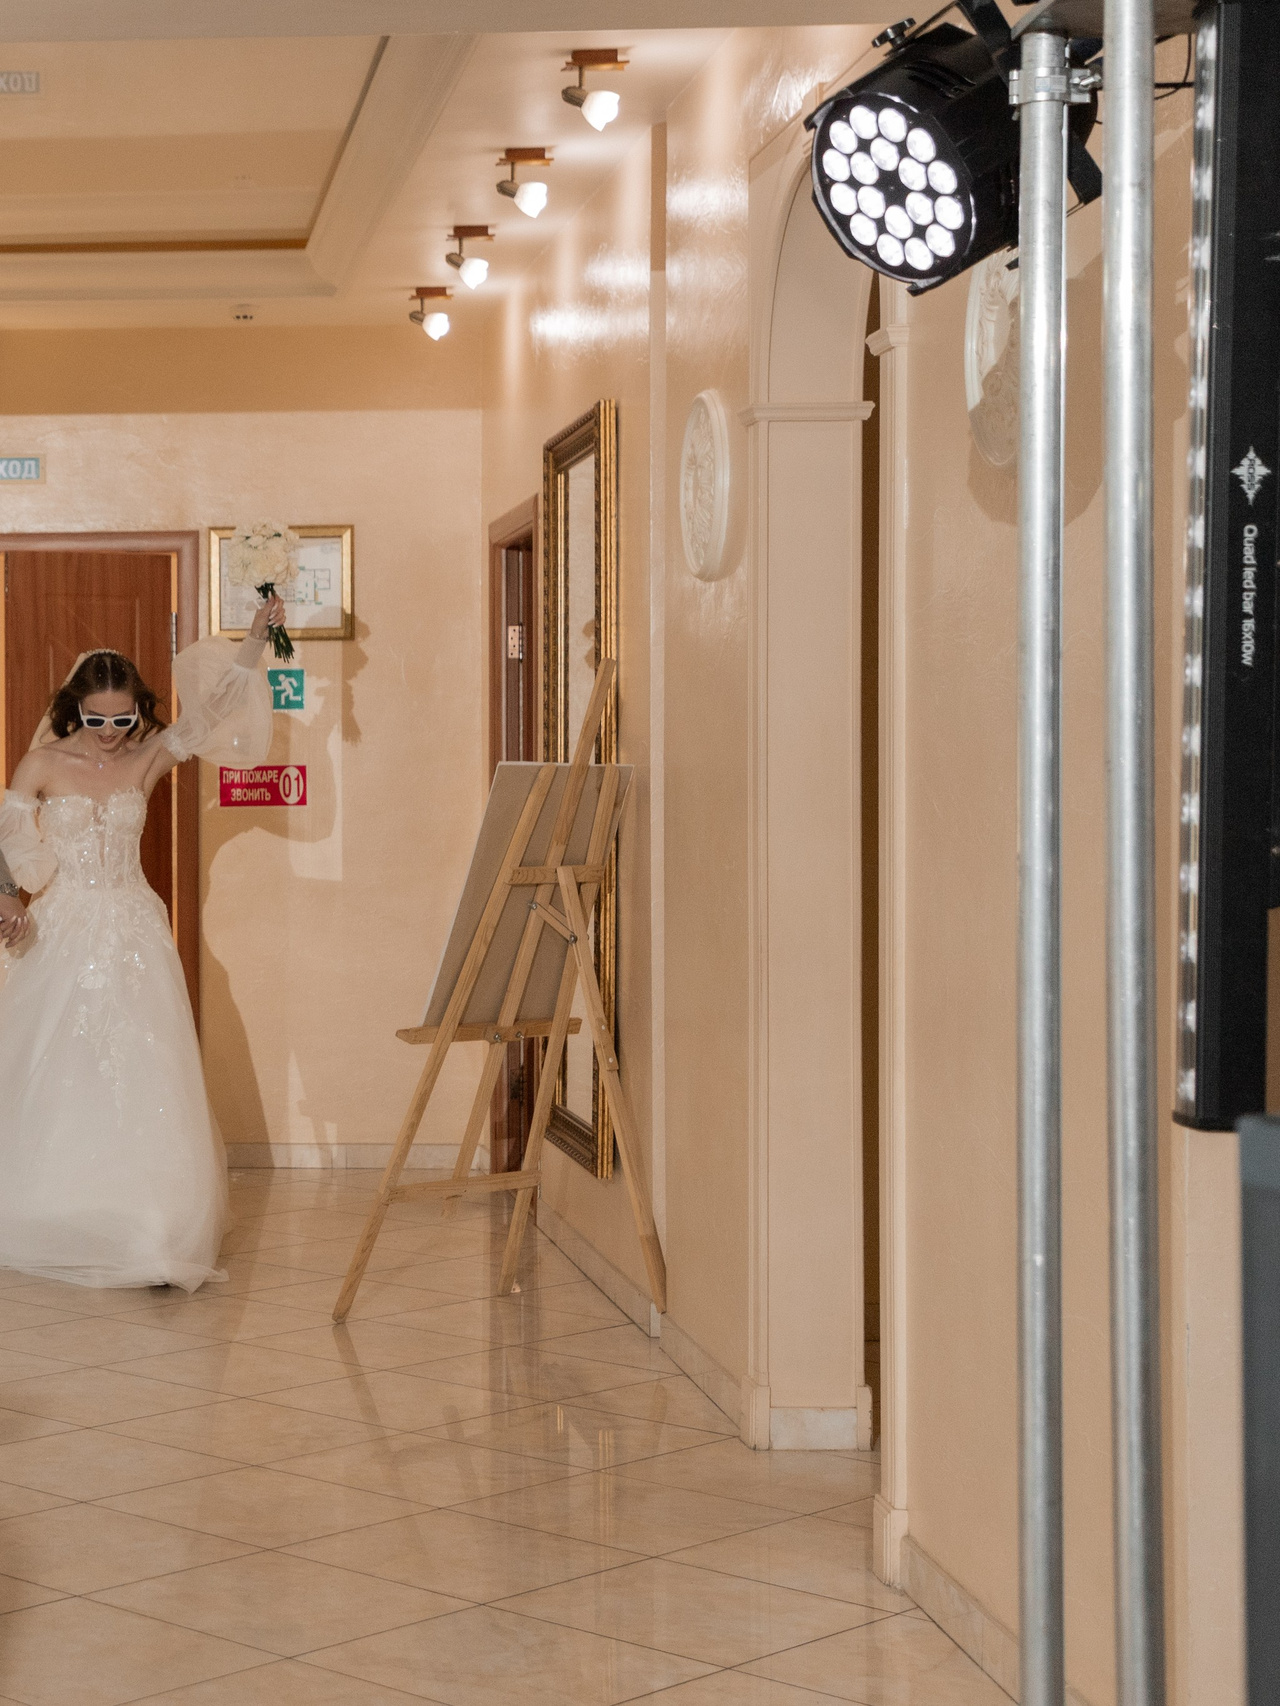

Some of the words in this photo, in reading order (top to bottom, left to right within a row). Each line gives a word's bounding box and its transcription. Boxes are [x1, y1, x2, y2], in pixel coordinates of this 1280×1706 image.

[1242, 524, 1259, 565] Quad
[1242, 567, 1258, 589] led
[1241, 591, 1257, 615] bar
[1241, 617, 1256, 667] 16x10w
[222, 770, 241, 784] ПРИ
[242, 769, 279, 784] ПОЖАРЕ
[282, 773, 301, 799] 01
[230, 787, 271, 802] ЗВОНИТЬ
